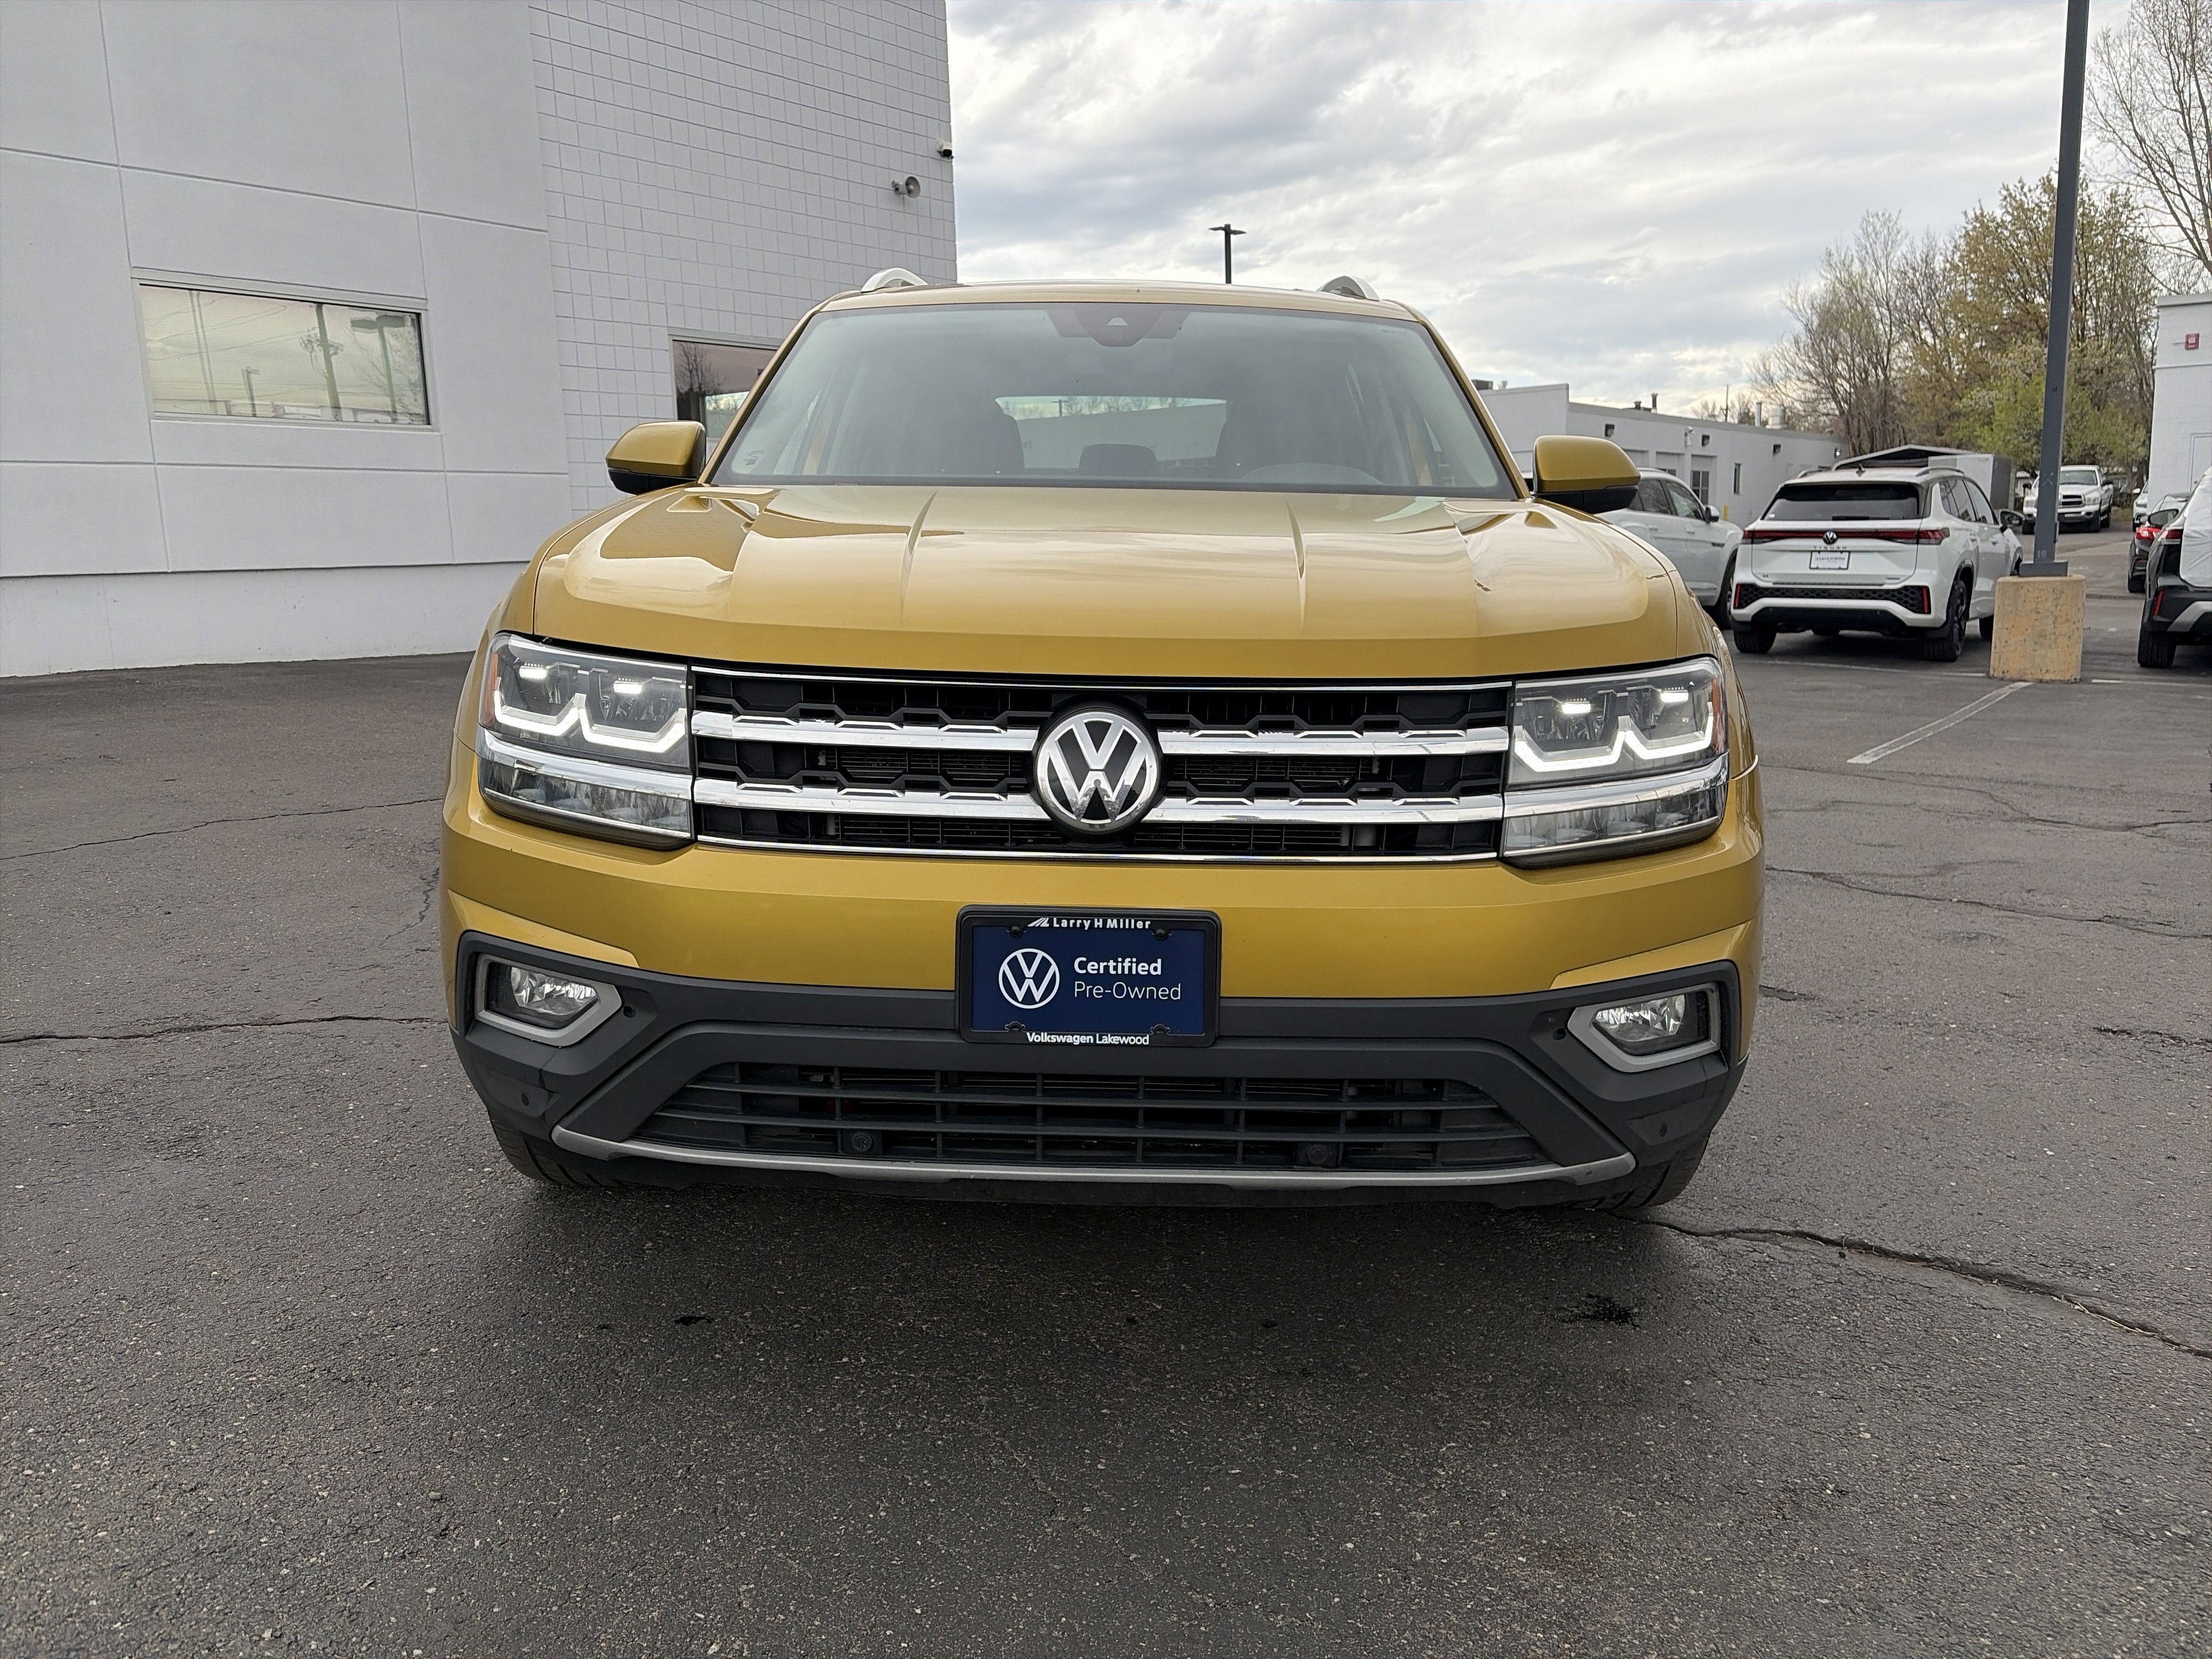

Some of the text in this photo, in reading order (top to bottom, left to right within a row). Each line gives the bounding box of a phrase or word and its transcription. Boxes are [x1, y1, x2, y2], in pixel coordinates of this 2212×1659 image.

[1053, 917, 1151, 930] Larry H Miller
[1074, 957, 1162, 975] Certified
[1074, 981, 1181, 1000] Pre-Owned
[1026, 1032, 1149, 1045] Volkswagen Lakewood
